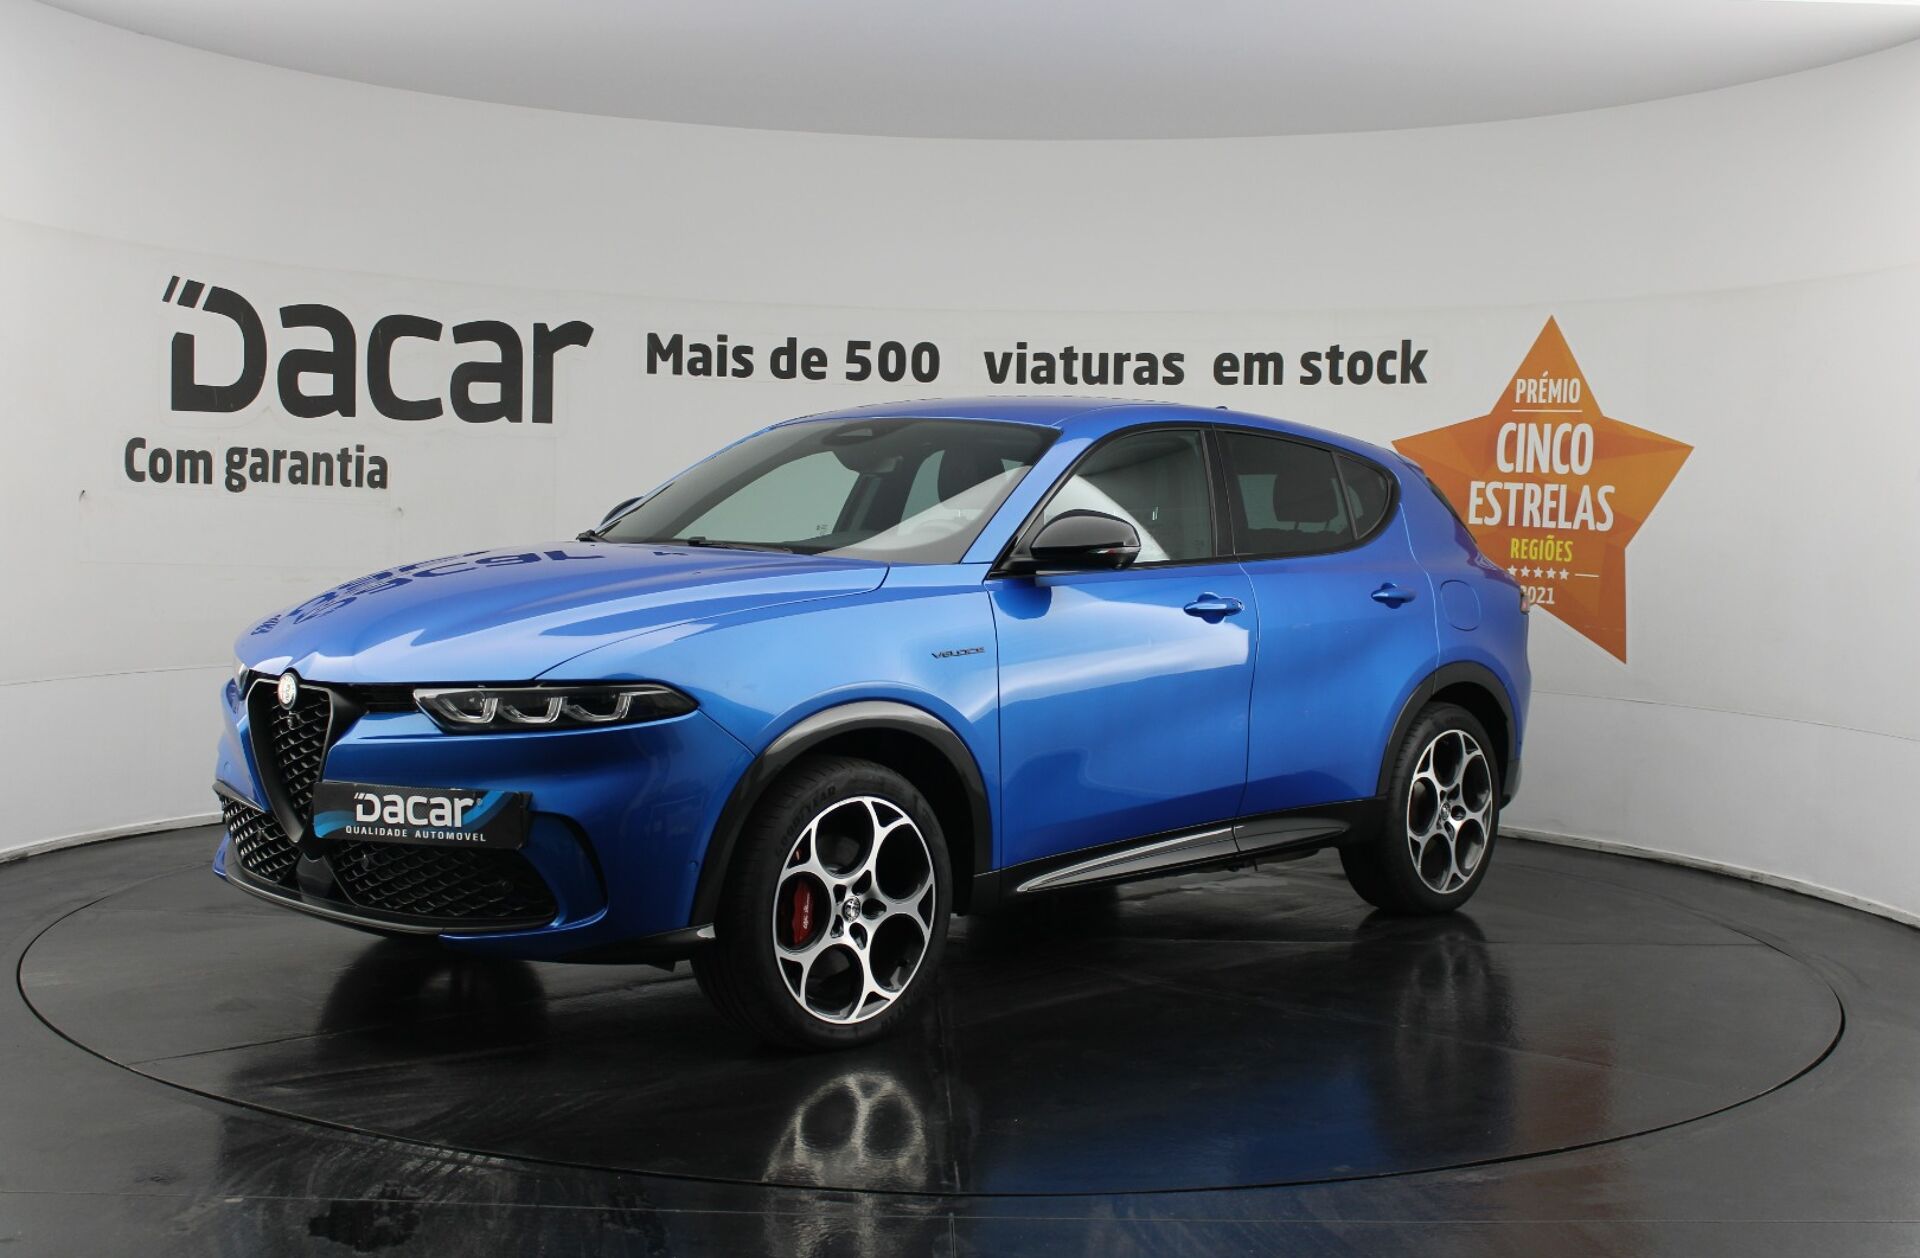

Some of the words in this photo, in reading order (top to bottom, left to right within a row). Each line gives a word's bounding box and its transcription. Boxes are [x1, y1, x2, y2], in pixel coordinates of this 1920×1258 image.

[162, 275, 594, 424] Dacar
[646, 332, 755, 379] Mais
[769, 336, 828, 381] de
[845, 340, 940, 383] 500
[983, 341, 1185, 386] viaturas
[1213, 351, 1284, 386] em
[1299, 339, 1429, 386] stock
[1514, 370, 1581, 404] PRÉMIO
[124, 437, 213, 485] Com
[224, 444, 388, 493] garantia
[1496, 422, 1594, 476] CINCO
[1468, 480, 1616, 532] ESTRELAS
[1510, 535, 1574, 563] REGIÕES
[931, 647, 985, 659] VELOCE
[353, 791, 475, 828] Dacar
[345, 825, 408, 838] QUALIDADE
[414, 830, 487, 842] AUTOMOVEL
